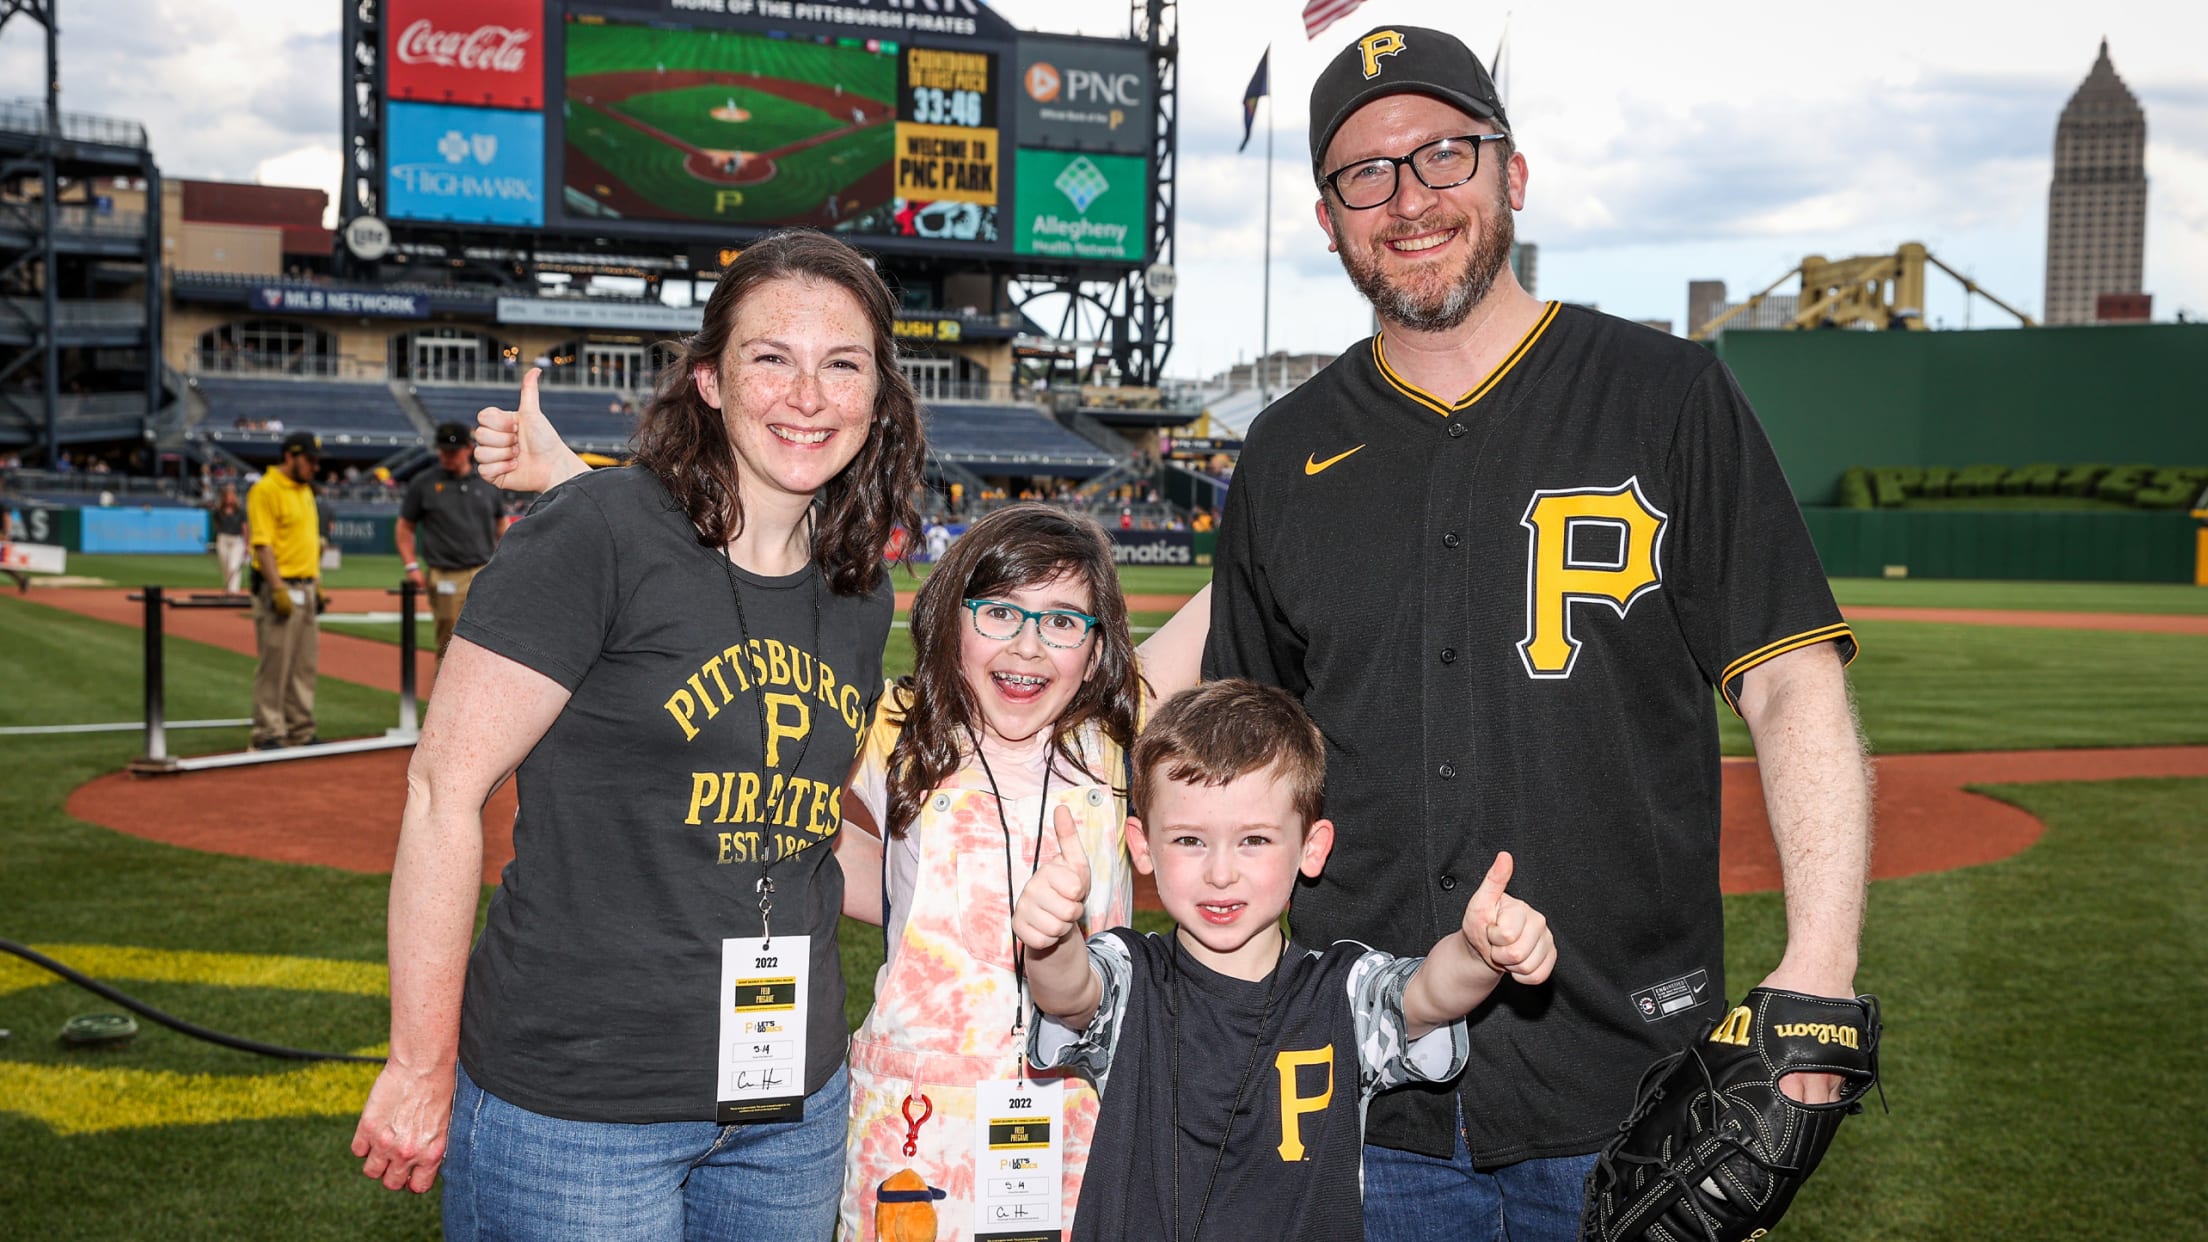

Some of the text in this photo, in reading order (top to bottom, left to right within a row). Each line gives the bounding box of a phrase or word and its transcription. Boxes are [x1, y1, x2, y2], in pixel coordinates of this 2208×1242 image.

[727, 0, 753, 14] OF
[757, 1, 793, 19] THE
[795, 3, 903, 28] PITTSBURGH
[905, 13, 976, 35] PIRATES
[1357, 29, 1407, 80] P
[1064, 69, 1140, 106] PNC
[913, 86, 981, 128] 33:46
[907, 137, 986, 160] WELCOME TO
[389, 163, 537, 202] HIGHMARK
[900, 158, 993, 192] PNC PARK
[353, 229, 383, 246] Lite
[1032, 215, 1128, 244] Allegheny
[1031, 240, 1125, 257] Health Network
[284, 290, 415, 314] MLB NETWORK
[1112, 539, 1190, 564] anatics
[1515, 475, 1669, 680] P
[764, 692, 810, 768] P
[684, 771, 842, 837] PIRATES
[717, 831, 764, 865] EST.
[755, 957, 778, 969] 2022
[1774, 1022, 1859, 1051] Wilson
[1009, 1098, 1032, 1109] 2022
[1275, 1043, 1334, 1162] P
